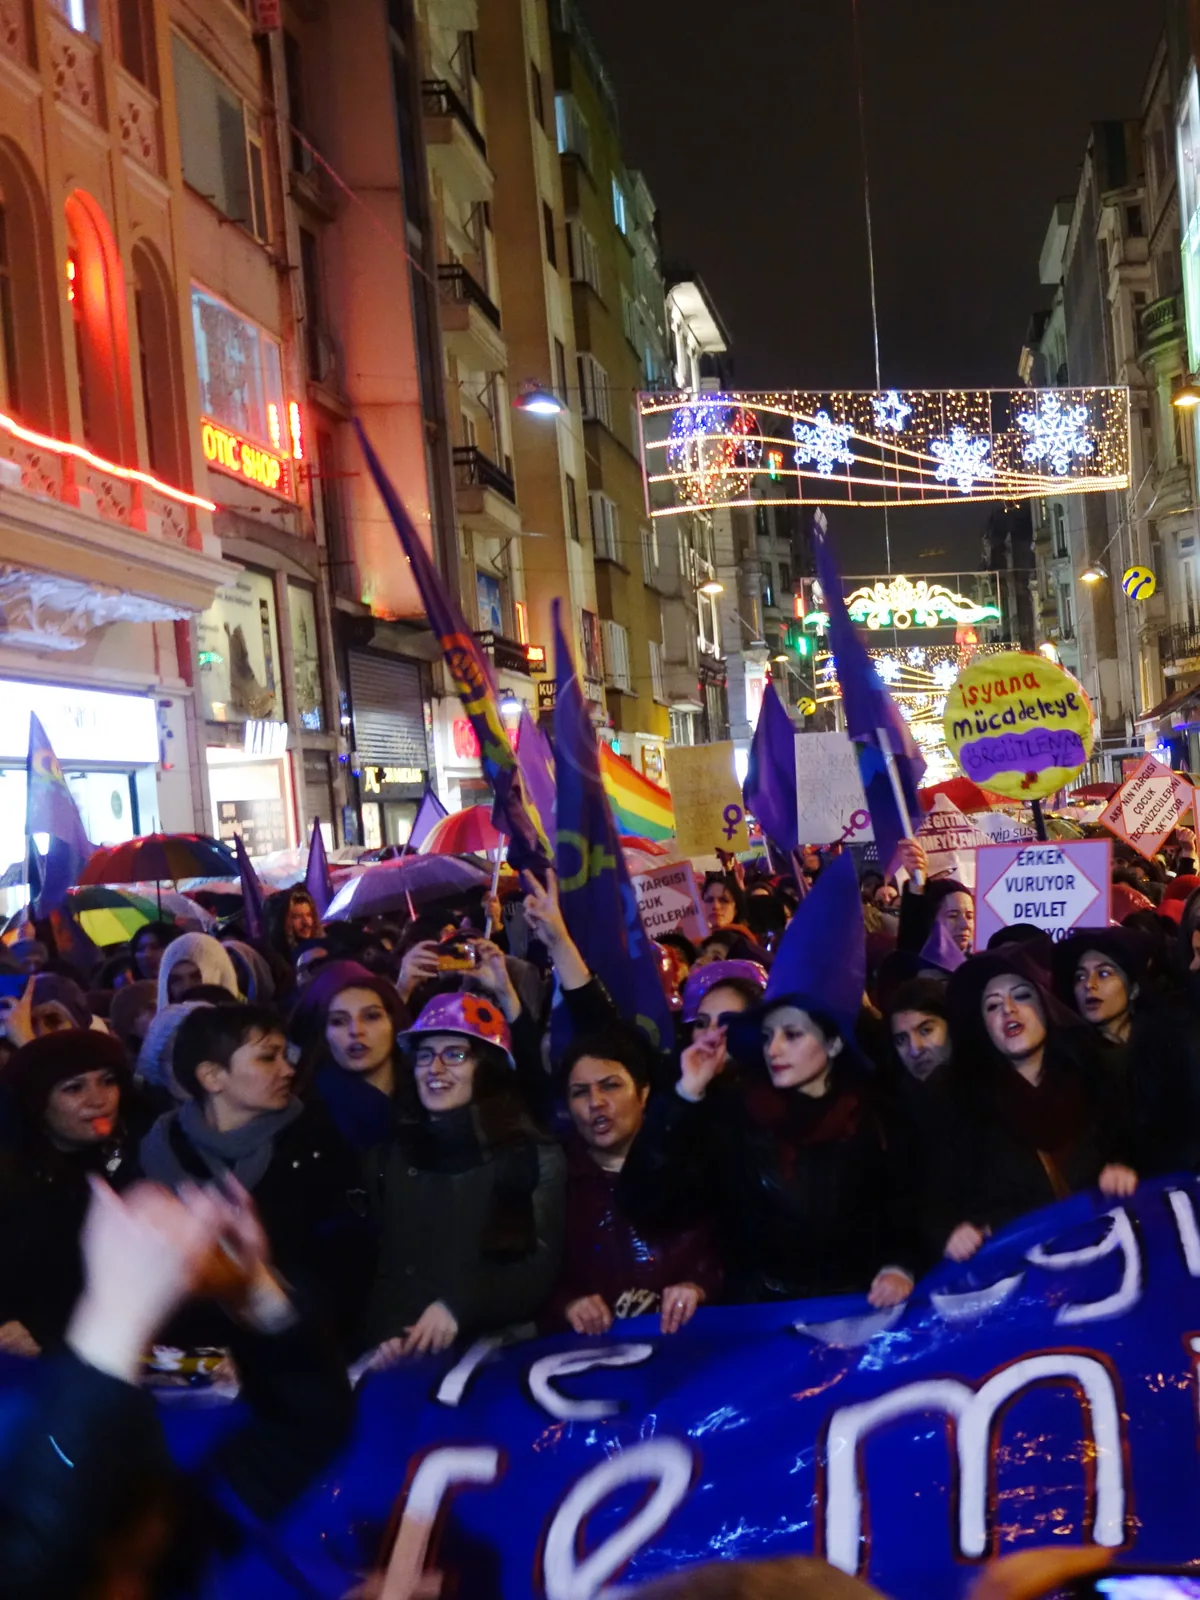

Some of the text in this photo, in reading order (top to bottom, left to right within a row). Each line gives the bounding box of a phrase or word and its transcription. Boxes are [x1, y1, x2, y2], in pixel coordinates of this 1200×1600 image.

[203, 424, 240, 472] OTIC
[241, 443, 281, 489] SHOP
[958, 672, 1041, 709] isyana
[1132, 763, 1158, 793] YARGISI
[1133, 787, 1157, 815] ÇOCUK
[1016, 849, 1066, 867] ERKEK
[638, 872, 687, 893] YARGISI
[1005, 874, 1076, 893] VURUYOR
[637, 896, 664, 912] CUK
[1013, 901, 1067, 919] DEVLET
[643, 904, 700, 928] CÜLERİNİ
